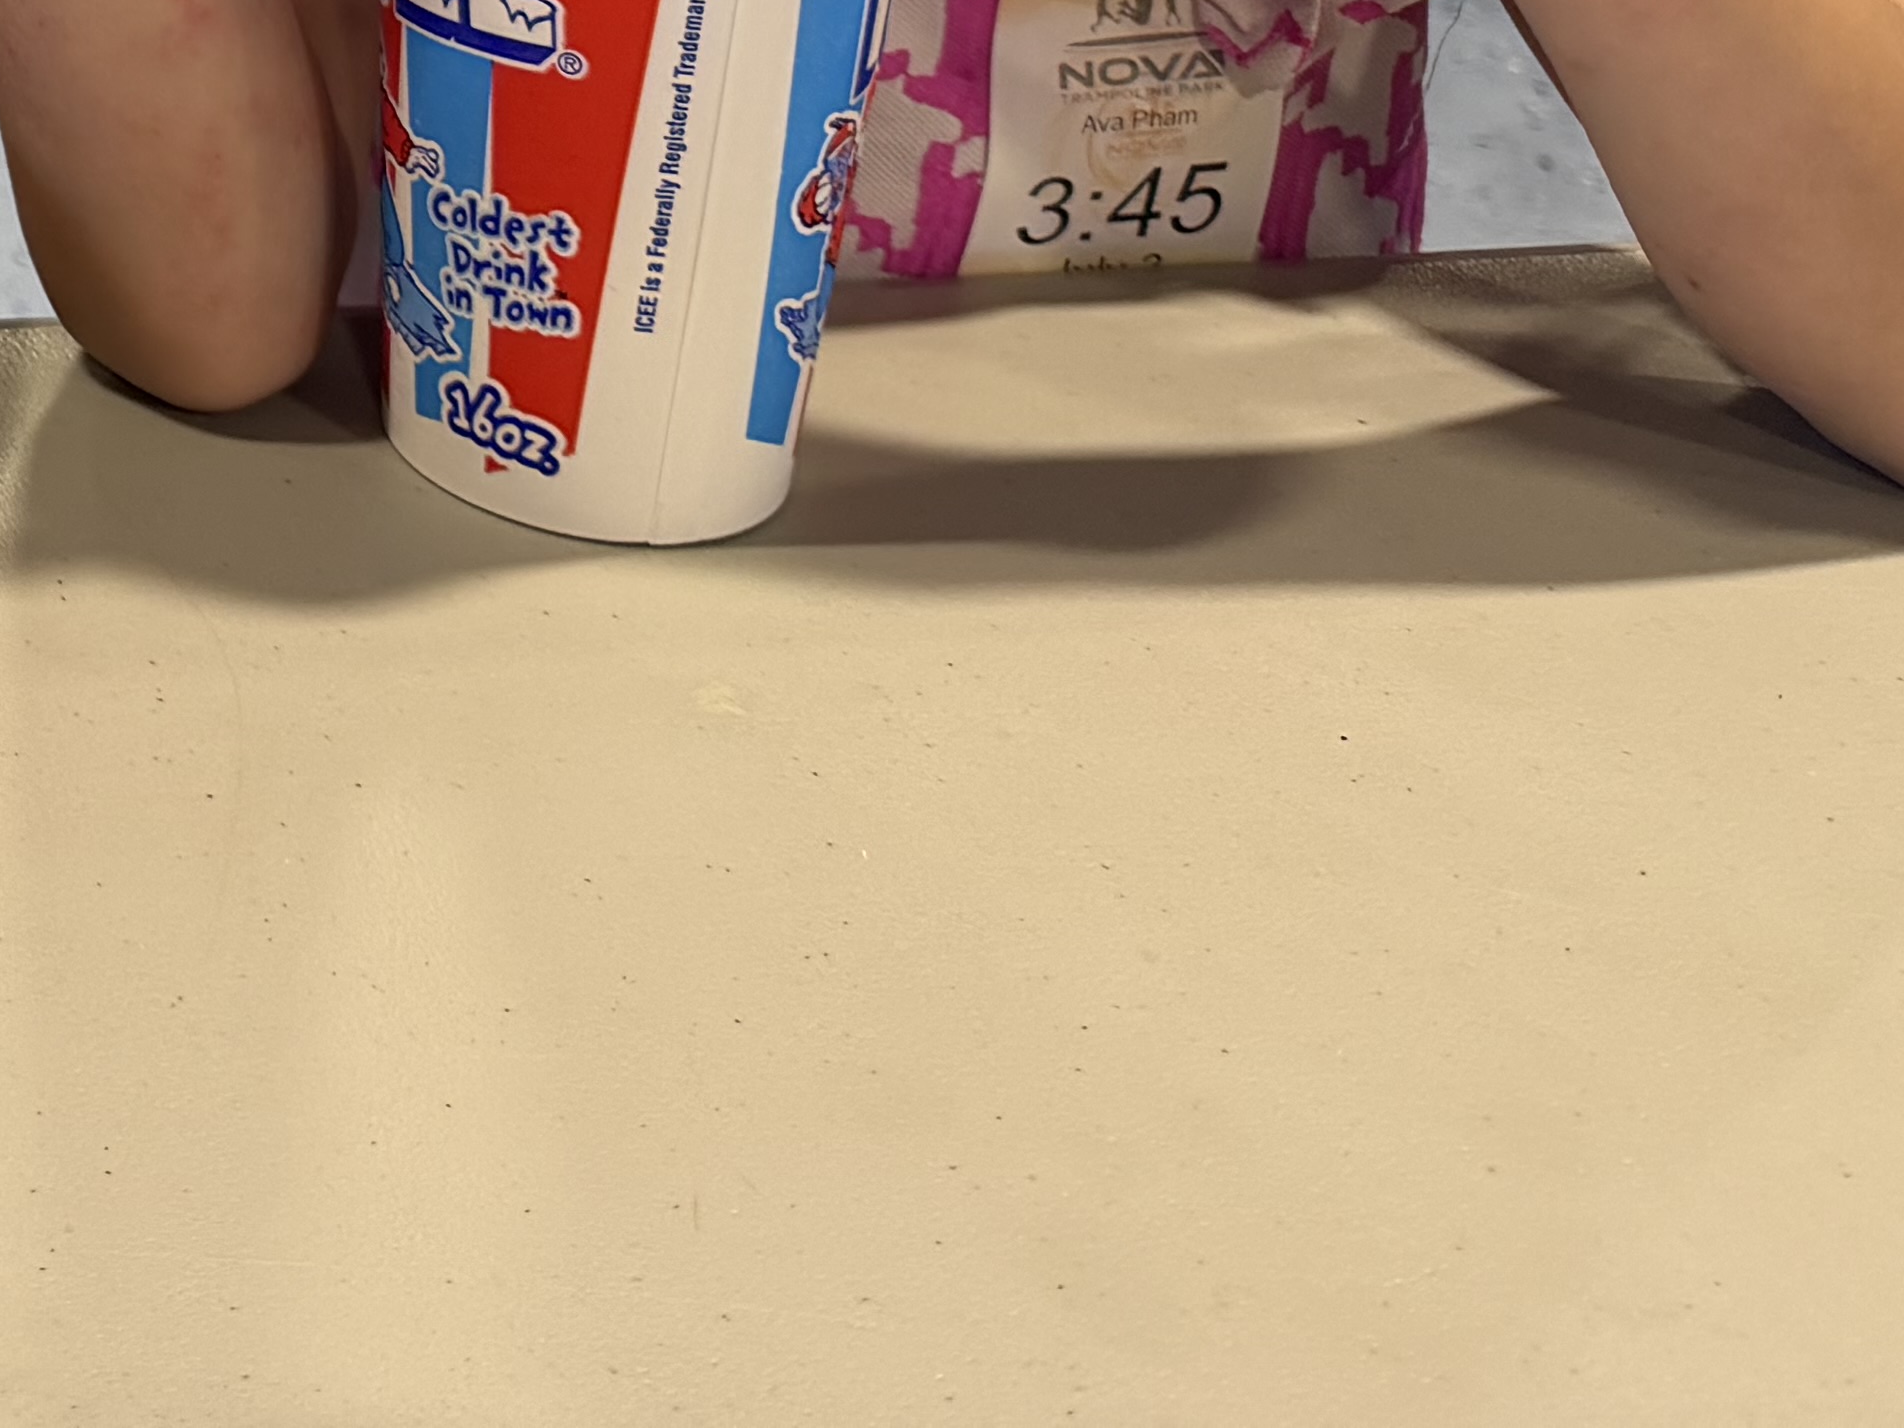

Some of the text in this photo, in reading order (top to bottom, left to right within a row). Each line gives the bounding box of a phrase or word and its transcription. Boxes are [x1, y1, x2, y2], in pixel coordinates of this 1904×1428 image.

[1058, 49, 1225, 90] NOVA
[1061, 81, 1224, 105] TRAMPOLINE PARK
[659, 83, 692, 175] Registered
[1081, 107, 1199, 134] Ava Pham
[432, 191, 574, 249] Coldest
[646, 178, 681, 257] Federally
[1016, 161, 1228, 245] 3:45
[453, 241, 550, 292] Drink
[647, 262, 664, 273] a
[446, 274, 574, 330] in Town
[633, 295, 658, 333] ICEE
[445, 380, 560, 476] 16oz.
